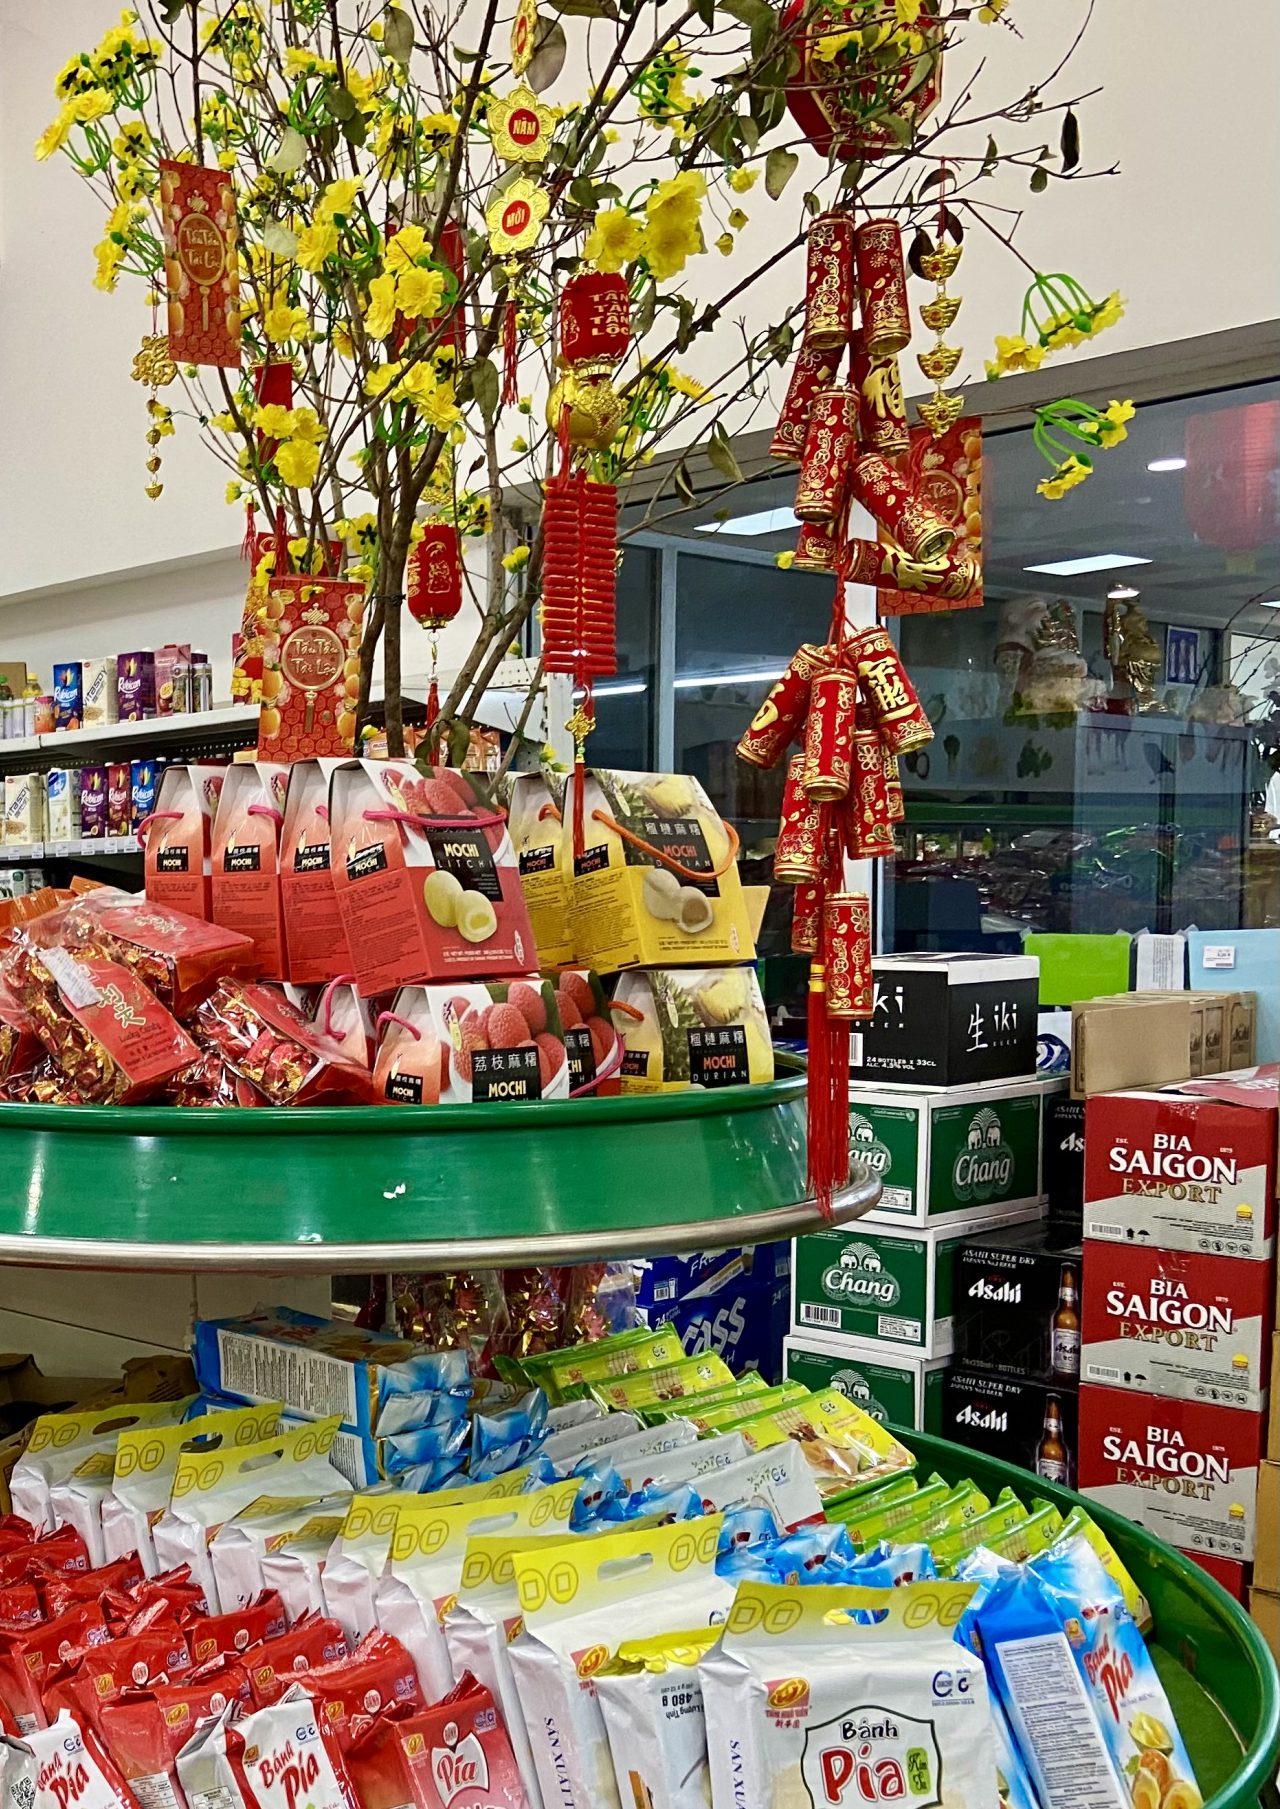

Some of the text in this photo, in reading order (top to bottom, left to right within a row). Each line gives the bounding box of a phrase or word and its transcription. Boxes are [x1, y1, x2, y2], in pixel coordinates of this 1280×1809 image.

[513, 117, 536, 135] NĂM
[506, 208, 526, 229] MỚI
[118, 676, 141, 693] Rubicon
[81, 790, 104, 806] Rubicon
[108, 787, 127, 805] Rubicon
[131, 785, 154, 801] Rubicon
[443, 843, 480, 858] MOCHI
[663, 845, 697, 857] MOCHI
[437, 859, 493, 869] LITCHI
[581, 857, 601, 869] MOCHI
[873, 983, 903, 1014] ki
[966, 1003, 988, 1052] 生
[993, 1001, 1018, 1032] iki
[703, 1054, 736, 1068] MOCHI
[692, 1069, 747, 1082] DURIAN
[393, 1086, 414, 1097] MOCHI
[488, 1080, 527, 1098] MOCHI
[1154, 1133, 1192, 1152] BIA
[850, 1150, 887, 1172] ang
[954, 1155, 1011, 1187] Chang
[1109, 1147, 1237, 1185] SAIGON
[1122, 1178, 1222, 1205] EXPORT
[962, 1249, 1037, 1265] ASAHI SUPER DRY
[824, 1269, 895, 1302] Chang
[968, 1278, 1022, 1304] Asahi
[1150, 1278, 1188, 1299] BIA
[1106, 1290, 1233, 1335] SAIGON
[1120, 1321, 1218, 1352] EXPORT
[998, 1363, 1026, 1375] BOTTLES
[951, 1375, 1023, 1394] ASAHI SUPER DRY
[955, 1404, 1008, 1432] Asahi
[1146, 1425, 1185, 1447] BIA
[1103, 1435, 1230, 1483] SAIGON
[1115, 1466, 1216, 1501] EXPORT
[1083, 1633, 1110, 1687] Bánh
[1100, 1648, 1134, 1724] Pía
[672, 1692, 693, 1706] 480
[841, 1718, 899, 1742] Bánh
[258, 1740, 294, 1790] Bánh
[436, 1754, 476, 1792] Pía
[819, 1742, 907, 1805] Pía
[49, 1760, 90, 1809] Pía
[280, 1751, 321, 1809] Pía
